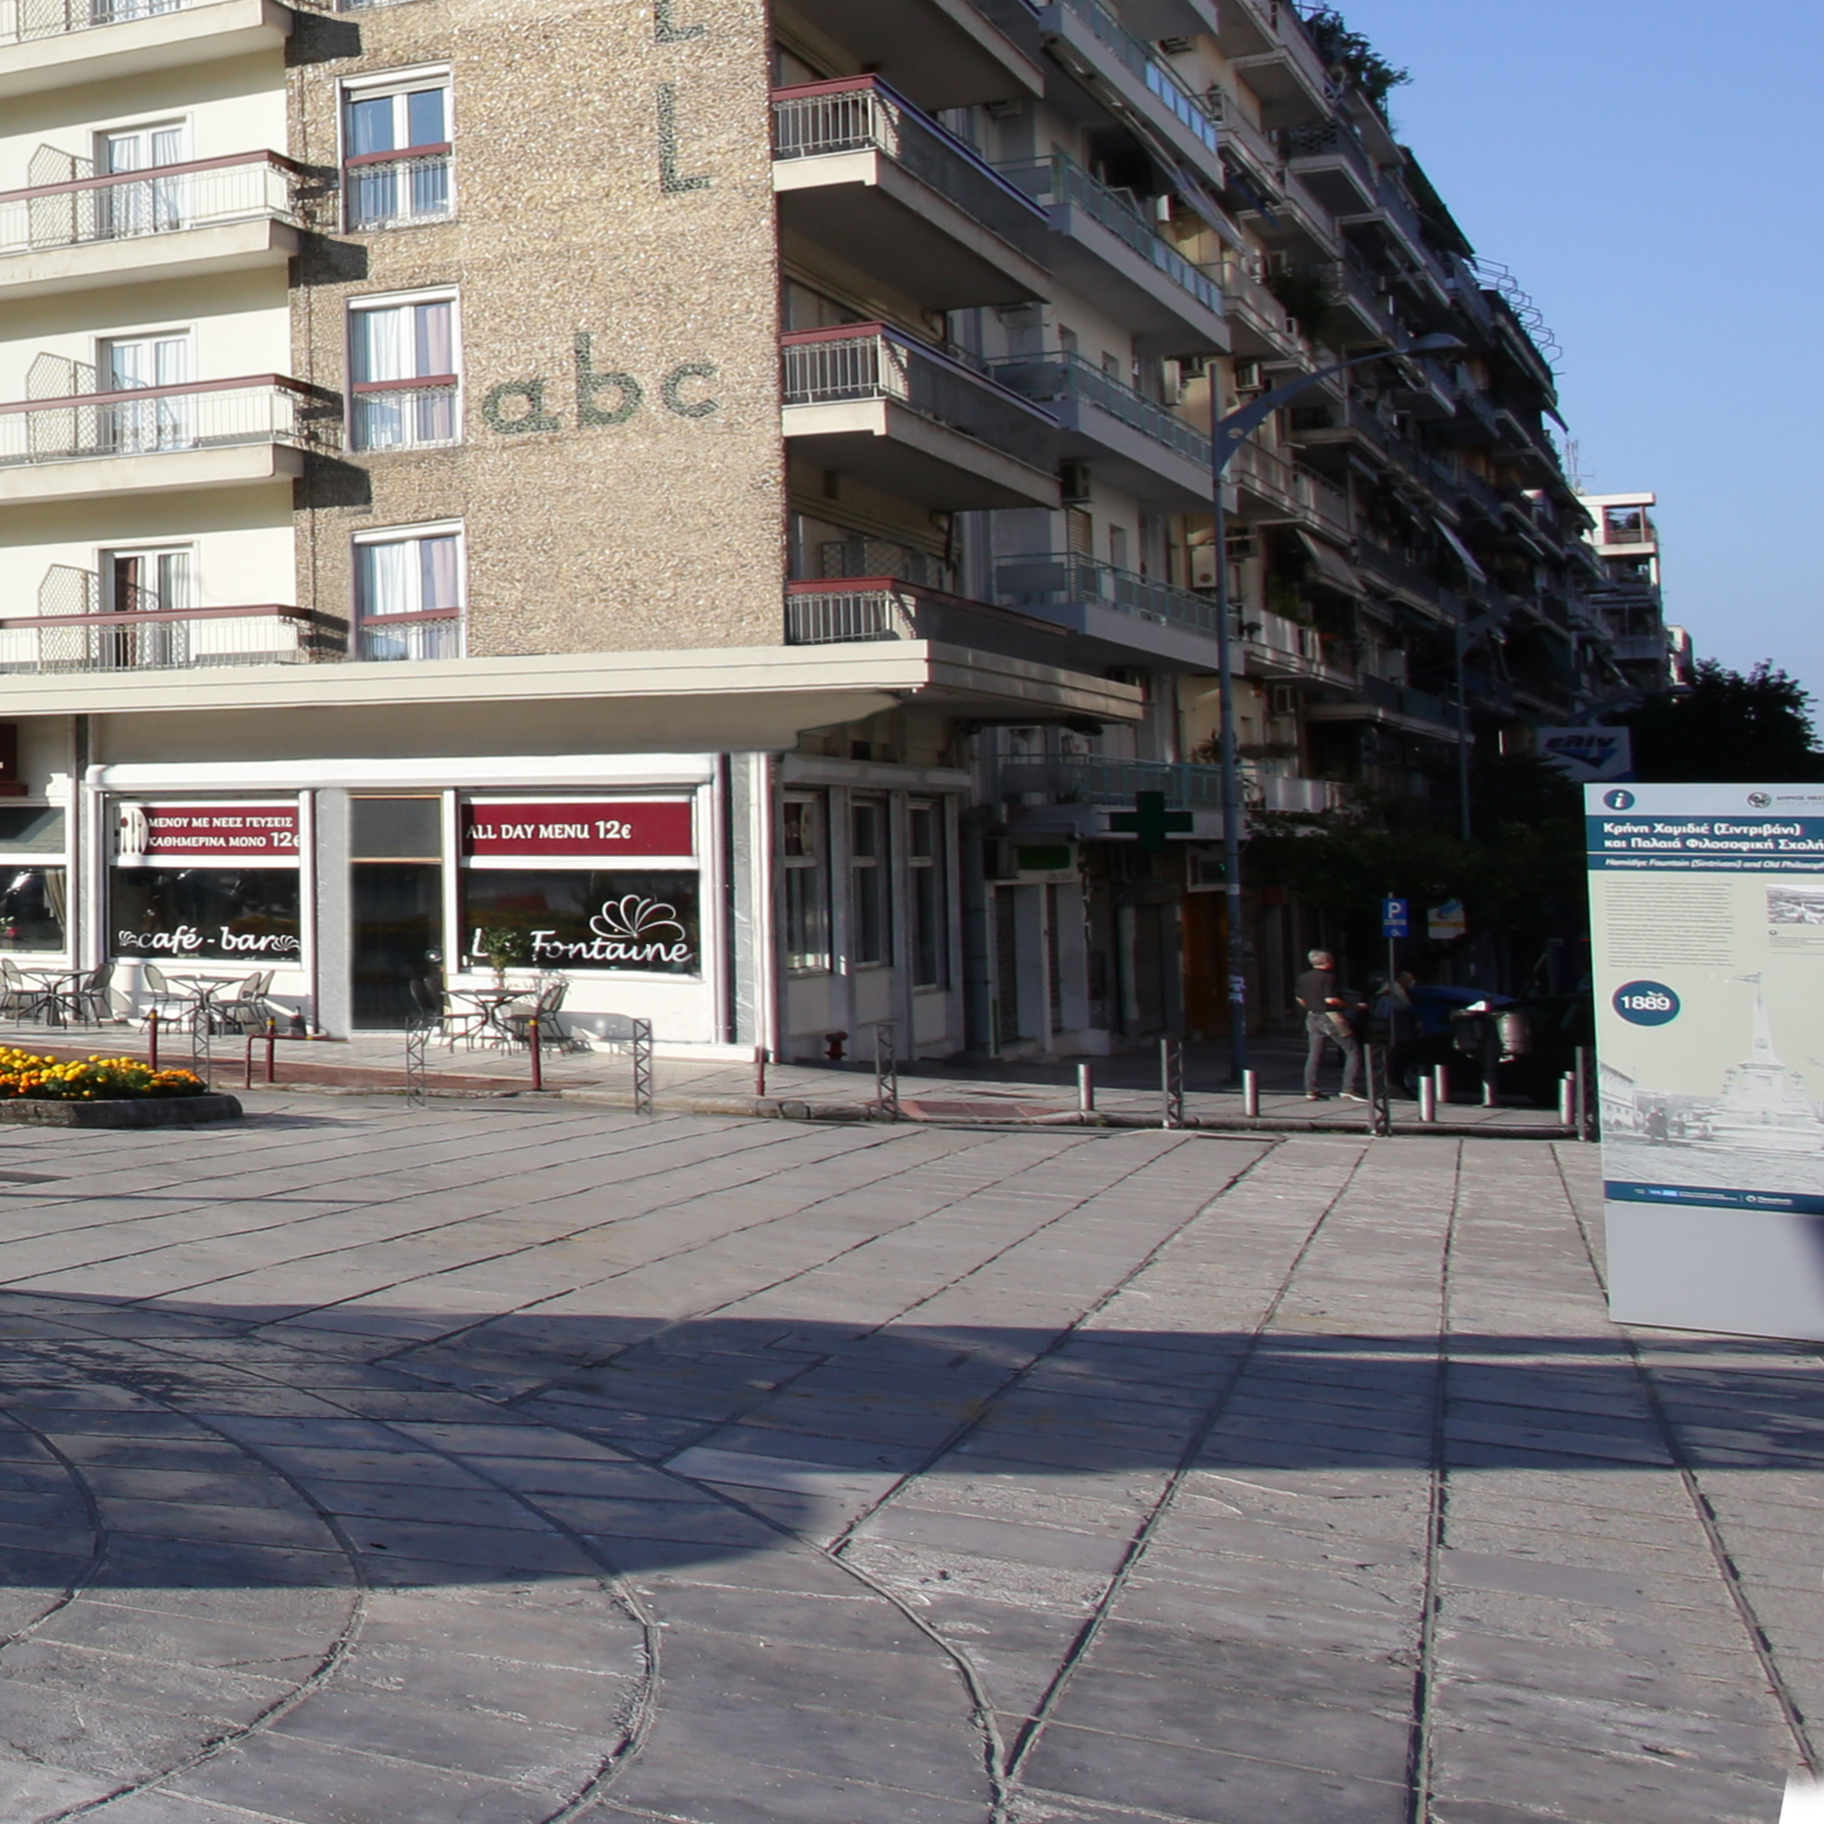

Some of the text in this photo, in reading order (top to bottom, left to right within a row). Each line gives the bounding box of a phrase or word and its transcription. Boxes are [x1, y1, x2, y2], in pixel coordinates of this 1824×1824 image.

[482, 332, 719, 434] abc
[212, 817, 243, 828] ΝΕΕΣ
[245, 817, 293, 827] ΓΕΥΣΕΙΣ
[466, 824, 497, 839] ALL
[500, 824, 535, 839] DAY
[595, 820, 632, 839] 12€
[1603, 822, 1801, 836] Κρήνη Χαμιδιέ (Σιντριβάνι)
[228, 836, 266, 848] ΜΟΝΟ
[1604, 839, 1627, 849] και
[1631, 837, 1682, 849] Παλαιά
[1686, 837, 1774, 852] Φιλοσοφική
[137, 925, 203, 954] café
[220, 926, 276, 952] bar
[1620, 995, 1670, 1011] 1889
